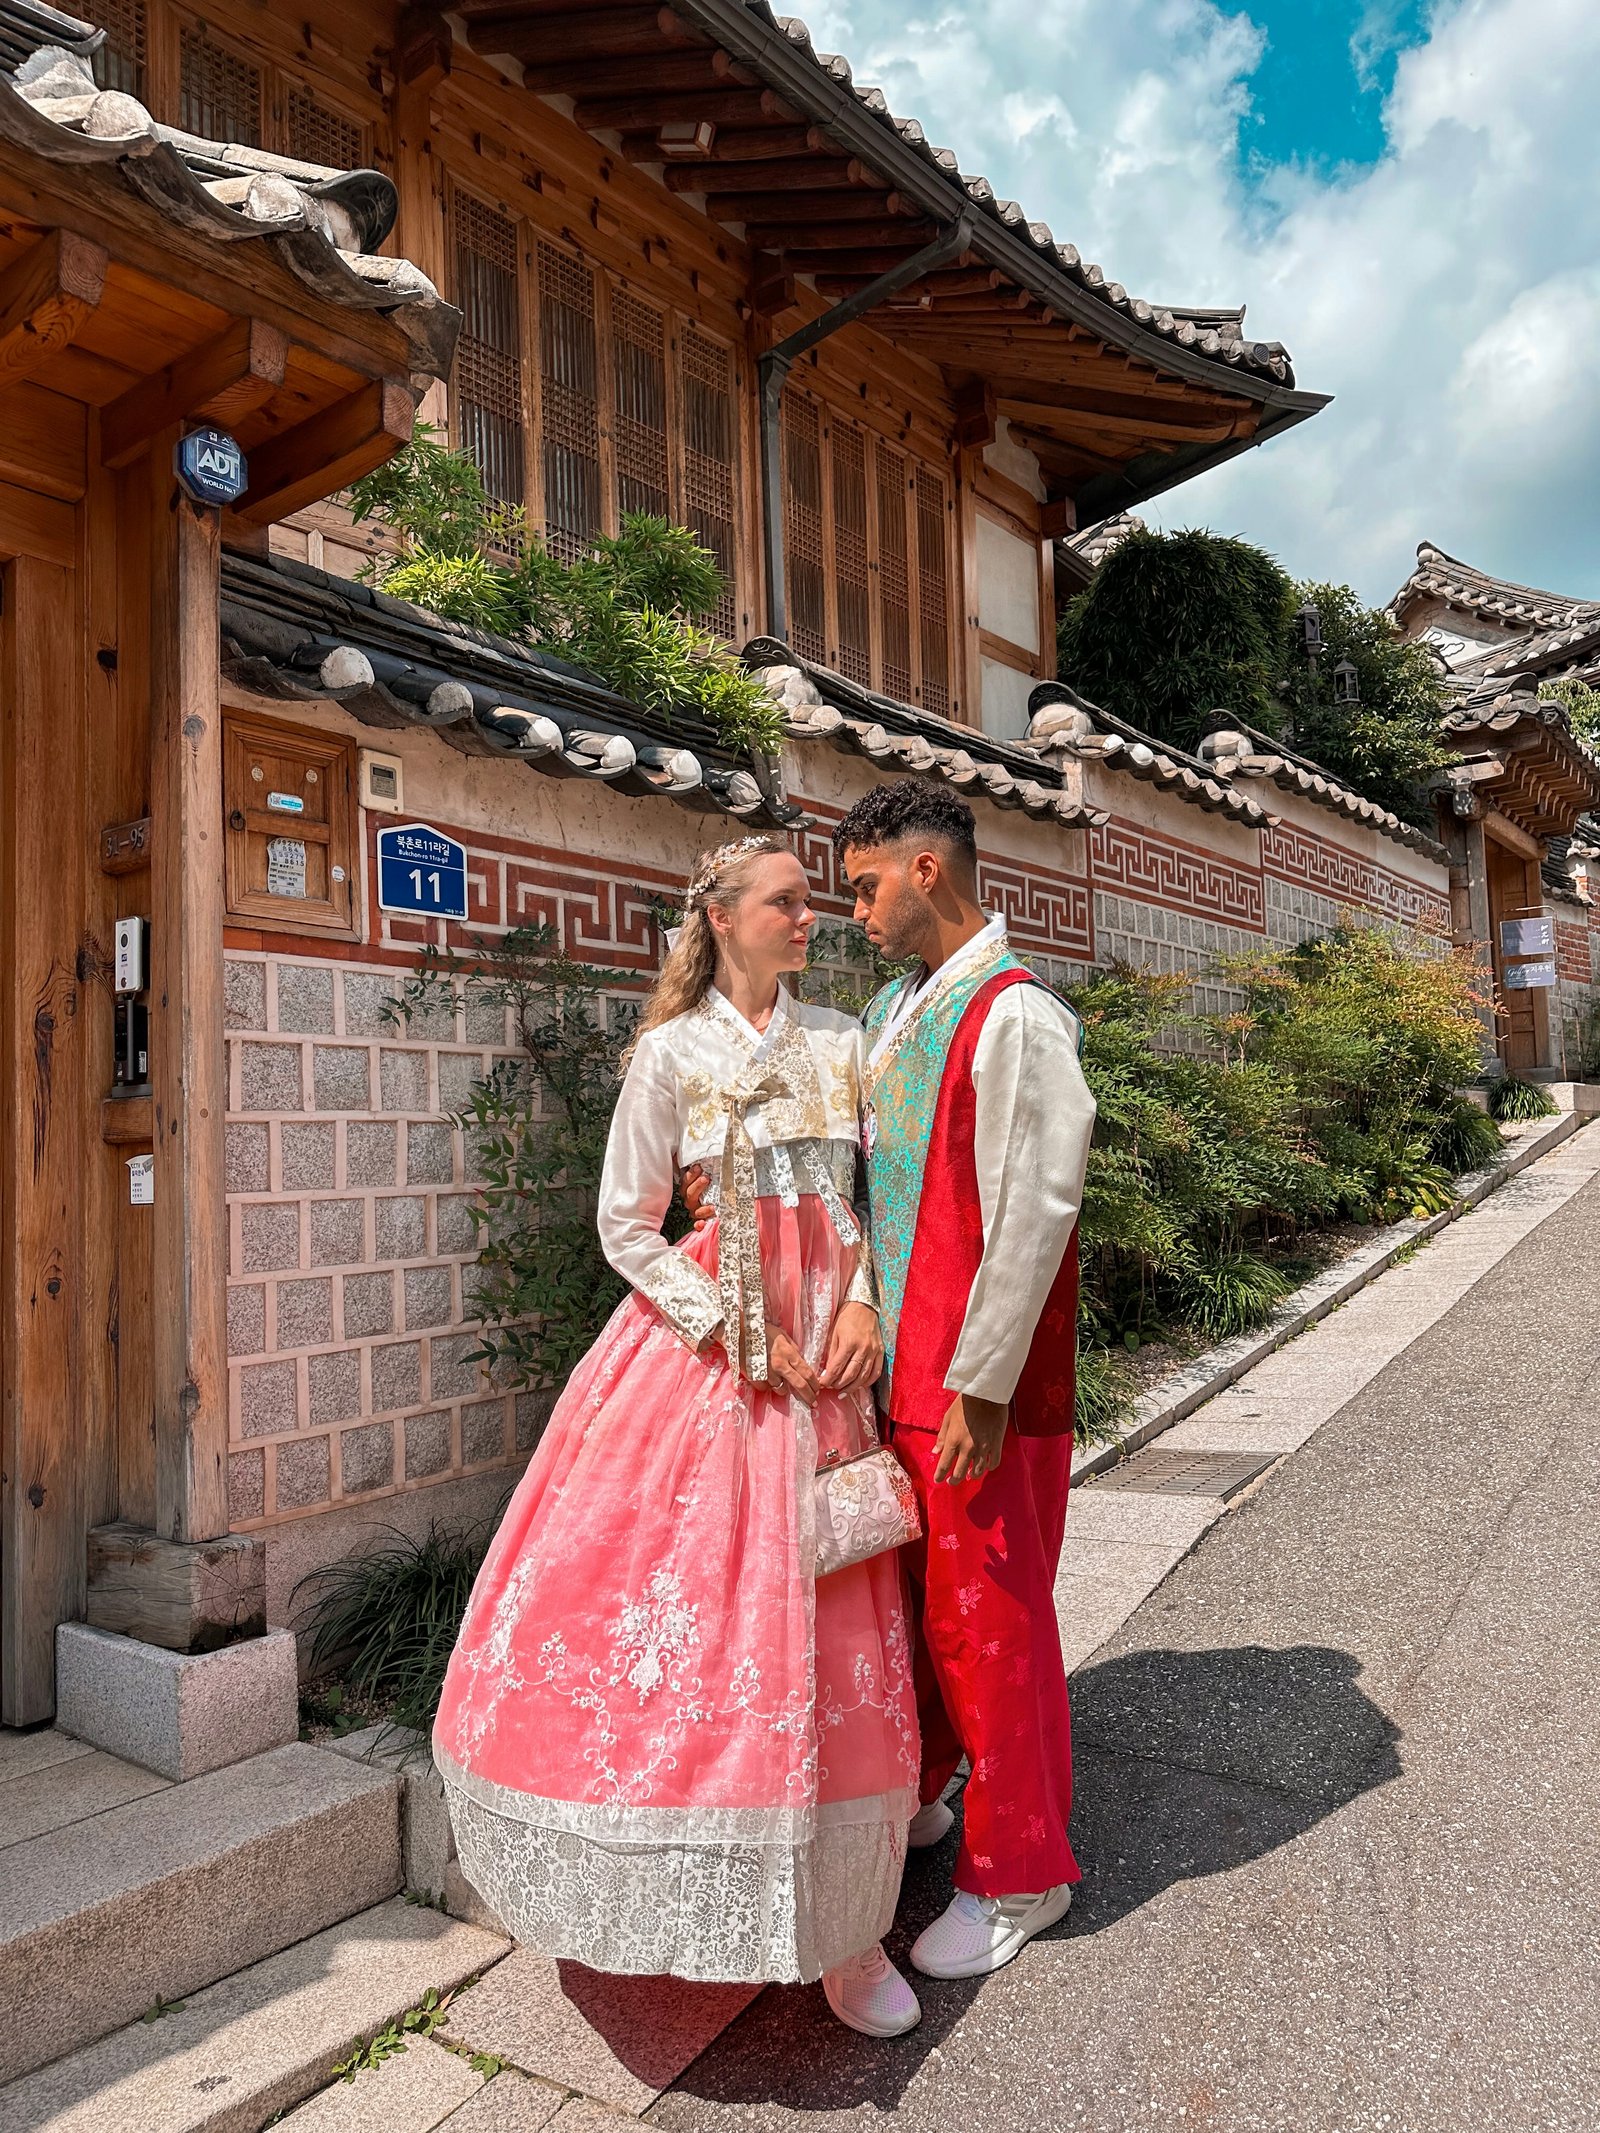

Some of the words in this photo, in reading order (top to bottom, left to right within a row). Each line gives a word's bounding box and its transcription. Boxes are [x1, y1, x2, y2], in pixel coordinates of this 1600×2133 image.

[198, 447, 239, 479] ADT
[202, 477, 224, 490] WORLD
[224, 485, 236, 495] No.1
[396, 834, 450, 857] 북촌로11라길
[398, 848, 429, 860] Bukchon-ro
[408, 868, 441, 903] 11
